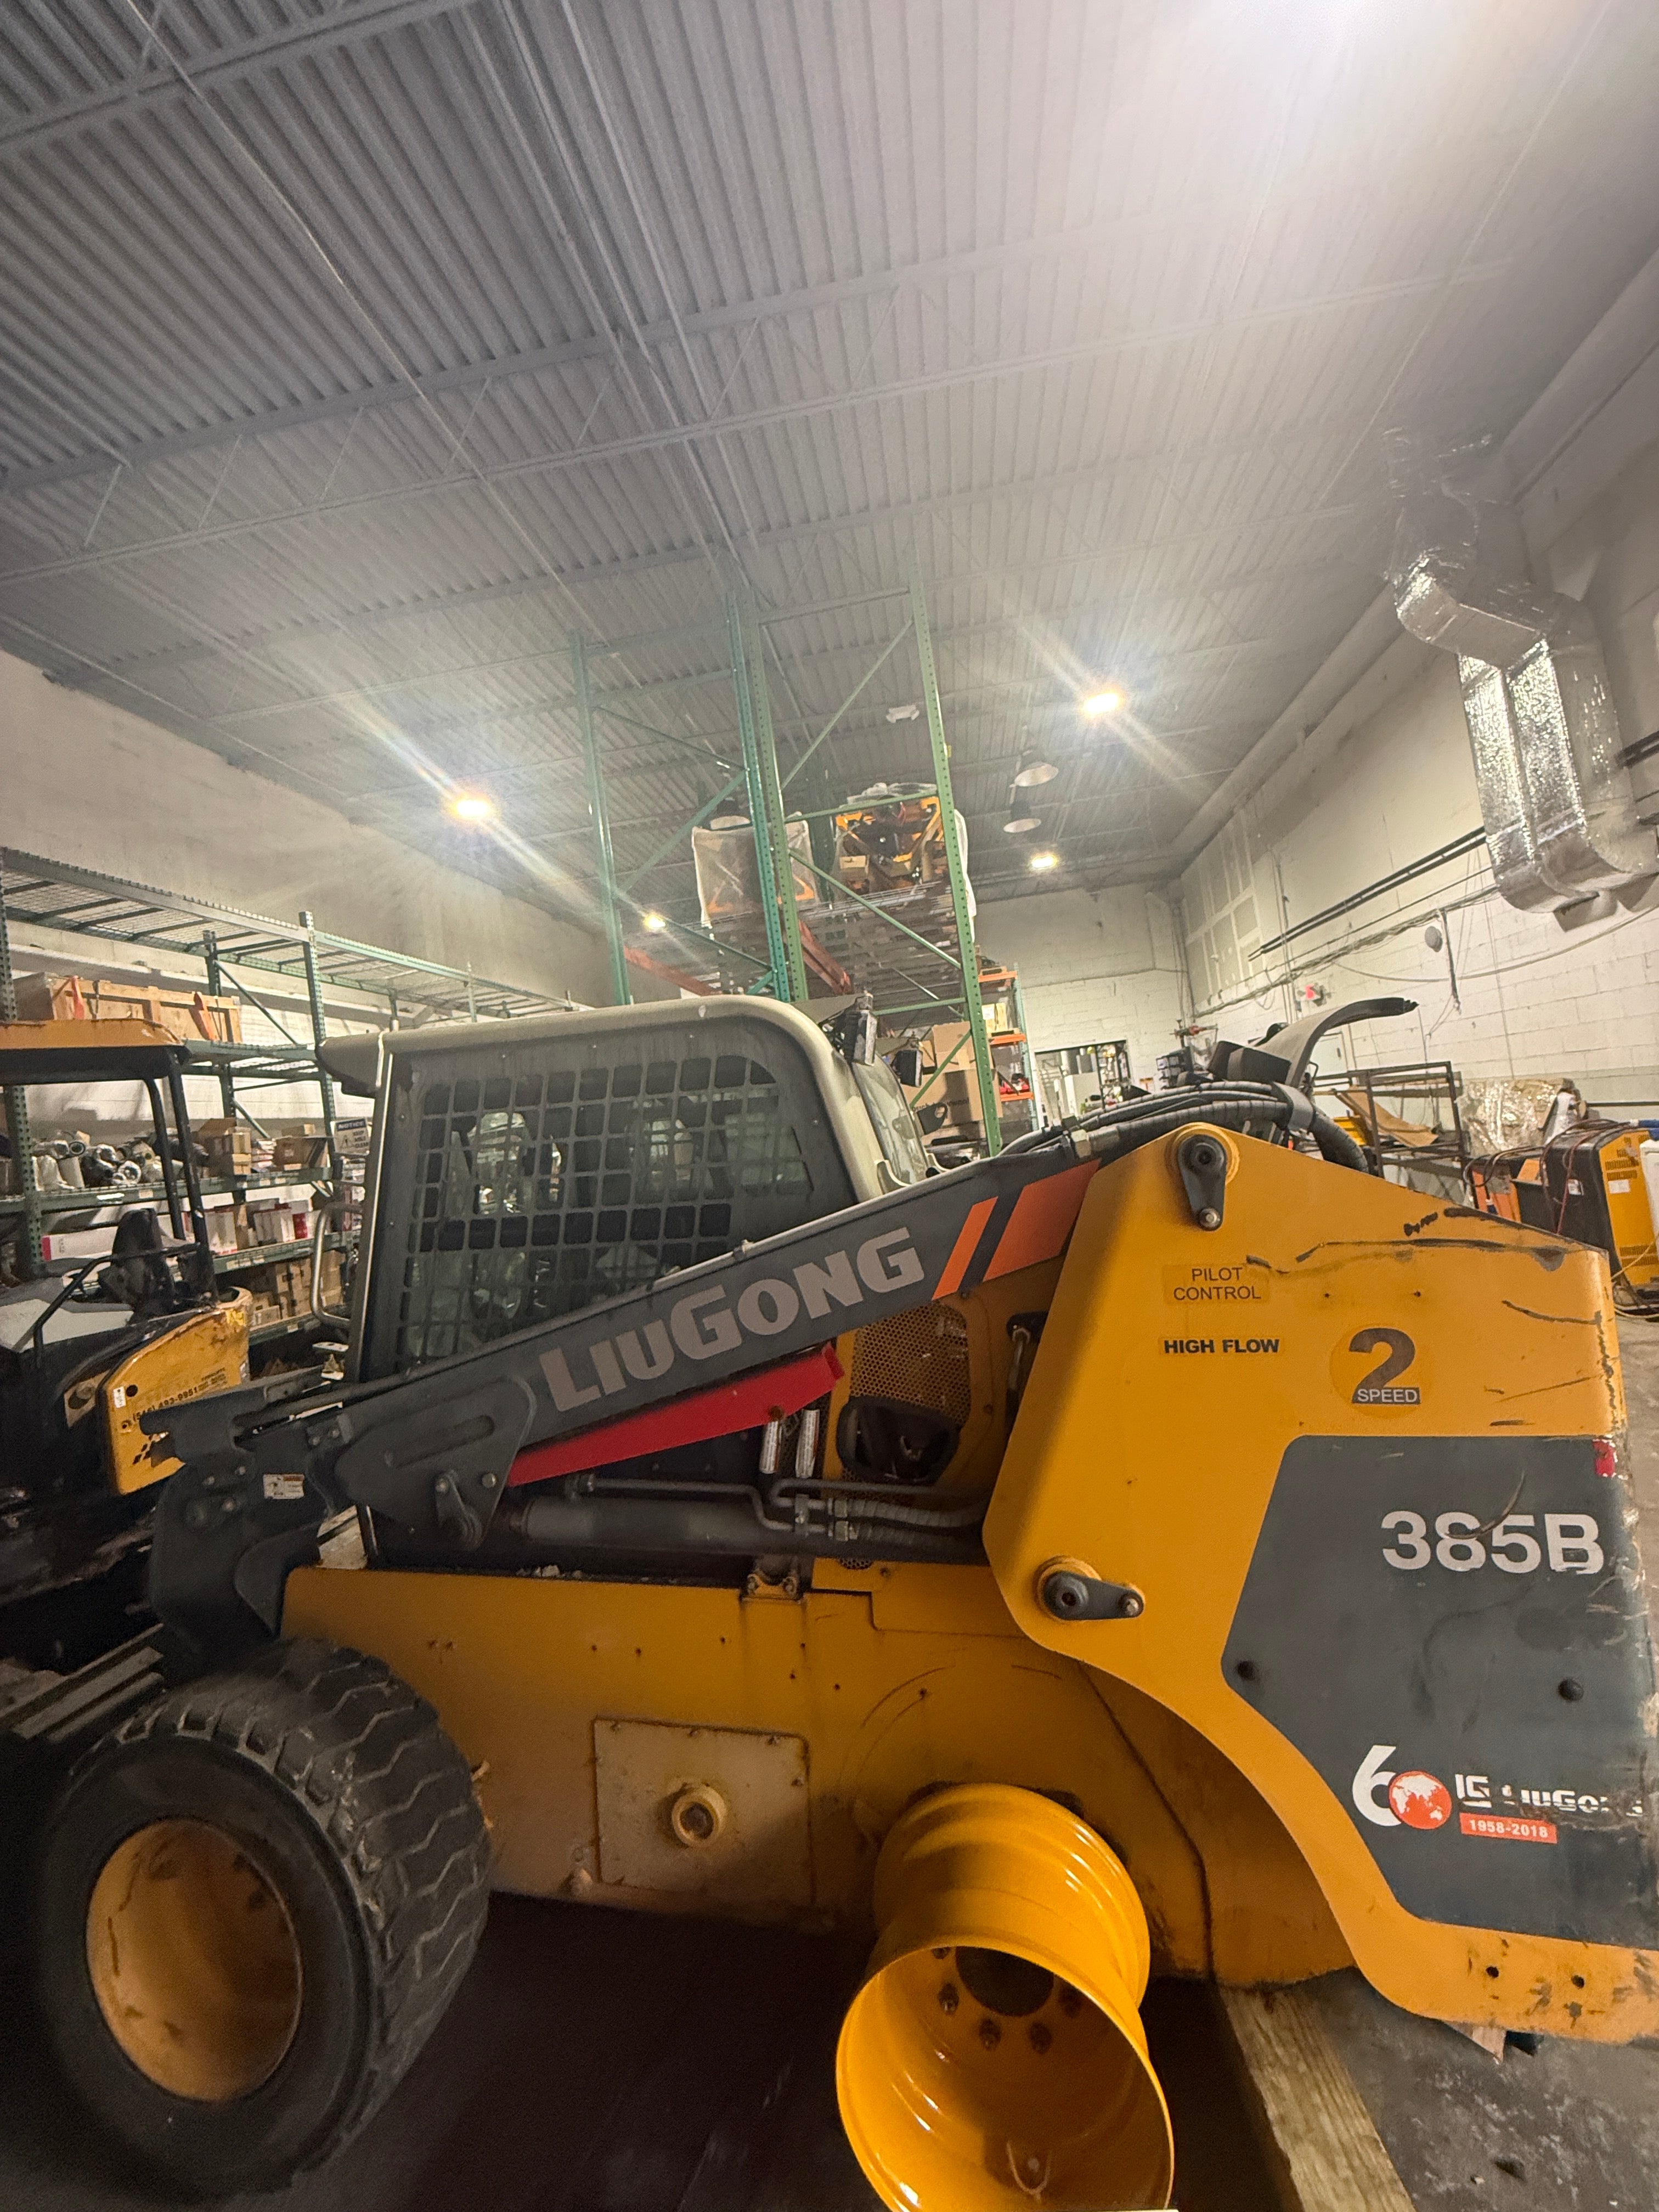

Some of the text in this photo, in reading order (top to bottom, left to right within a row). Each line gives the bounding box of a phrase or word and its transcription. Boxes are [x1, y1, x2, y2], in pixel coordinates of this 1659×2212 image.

[338, 1120, 365, 1129] NOTICE
[1192, 1267, 1243, 1282] PILOT
[1173, 1285, 1261, 1301] CONTROL
[539, 1227, 924, 1412] LIUGONG
[1164, 1339, 1280, 1353] HIGH FLOW
[1349, 1328, 1421, 1404] 2
[1357, 1389, 1418, 1403] SPEED
[1381, 1510, 1604, 1575] 385B
[1469, 1819, 1549, 1838] 1958-2018
